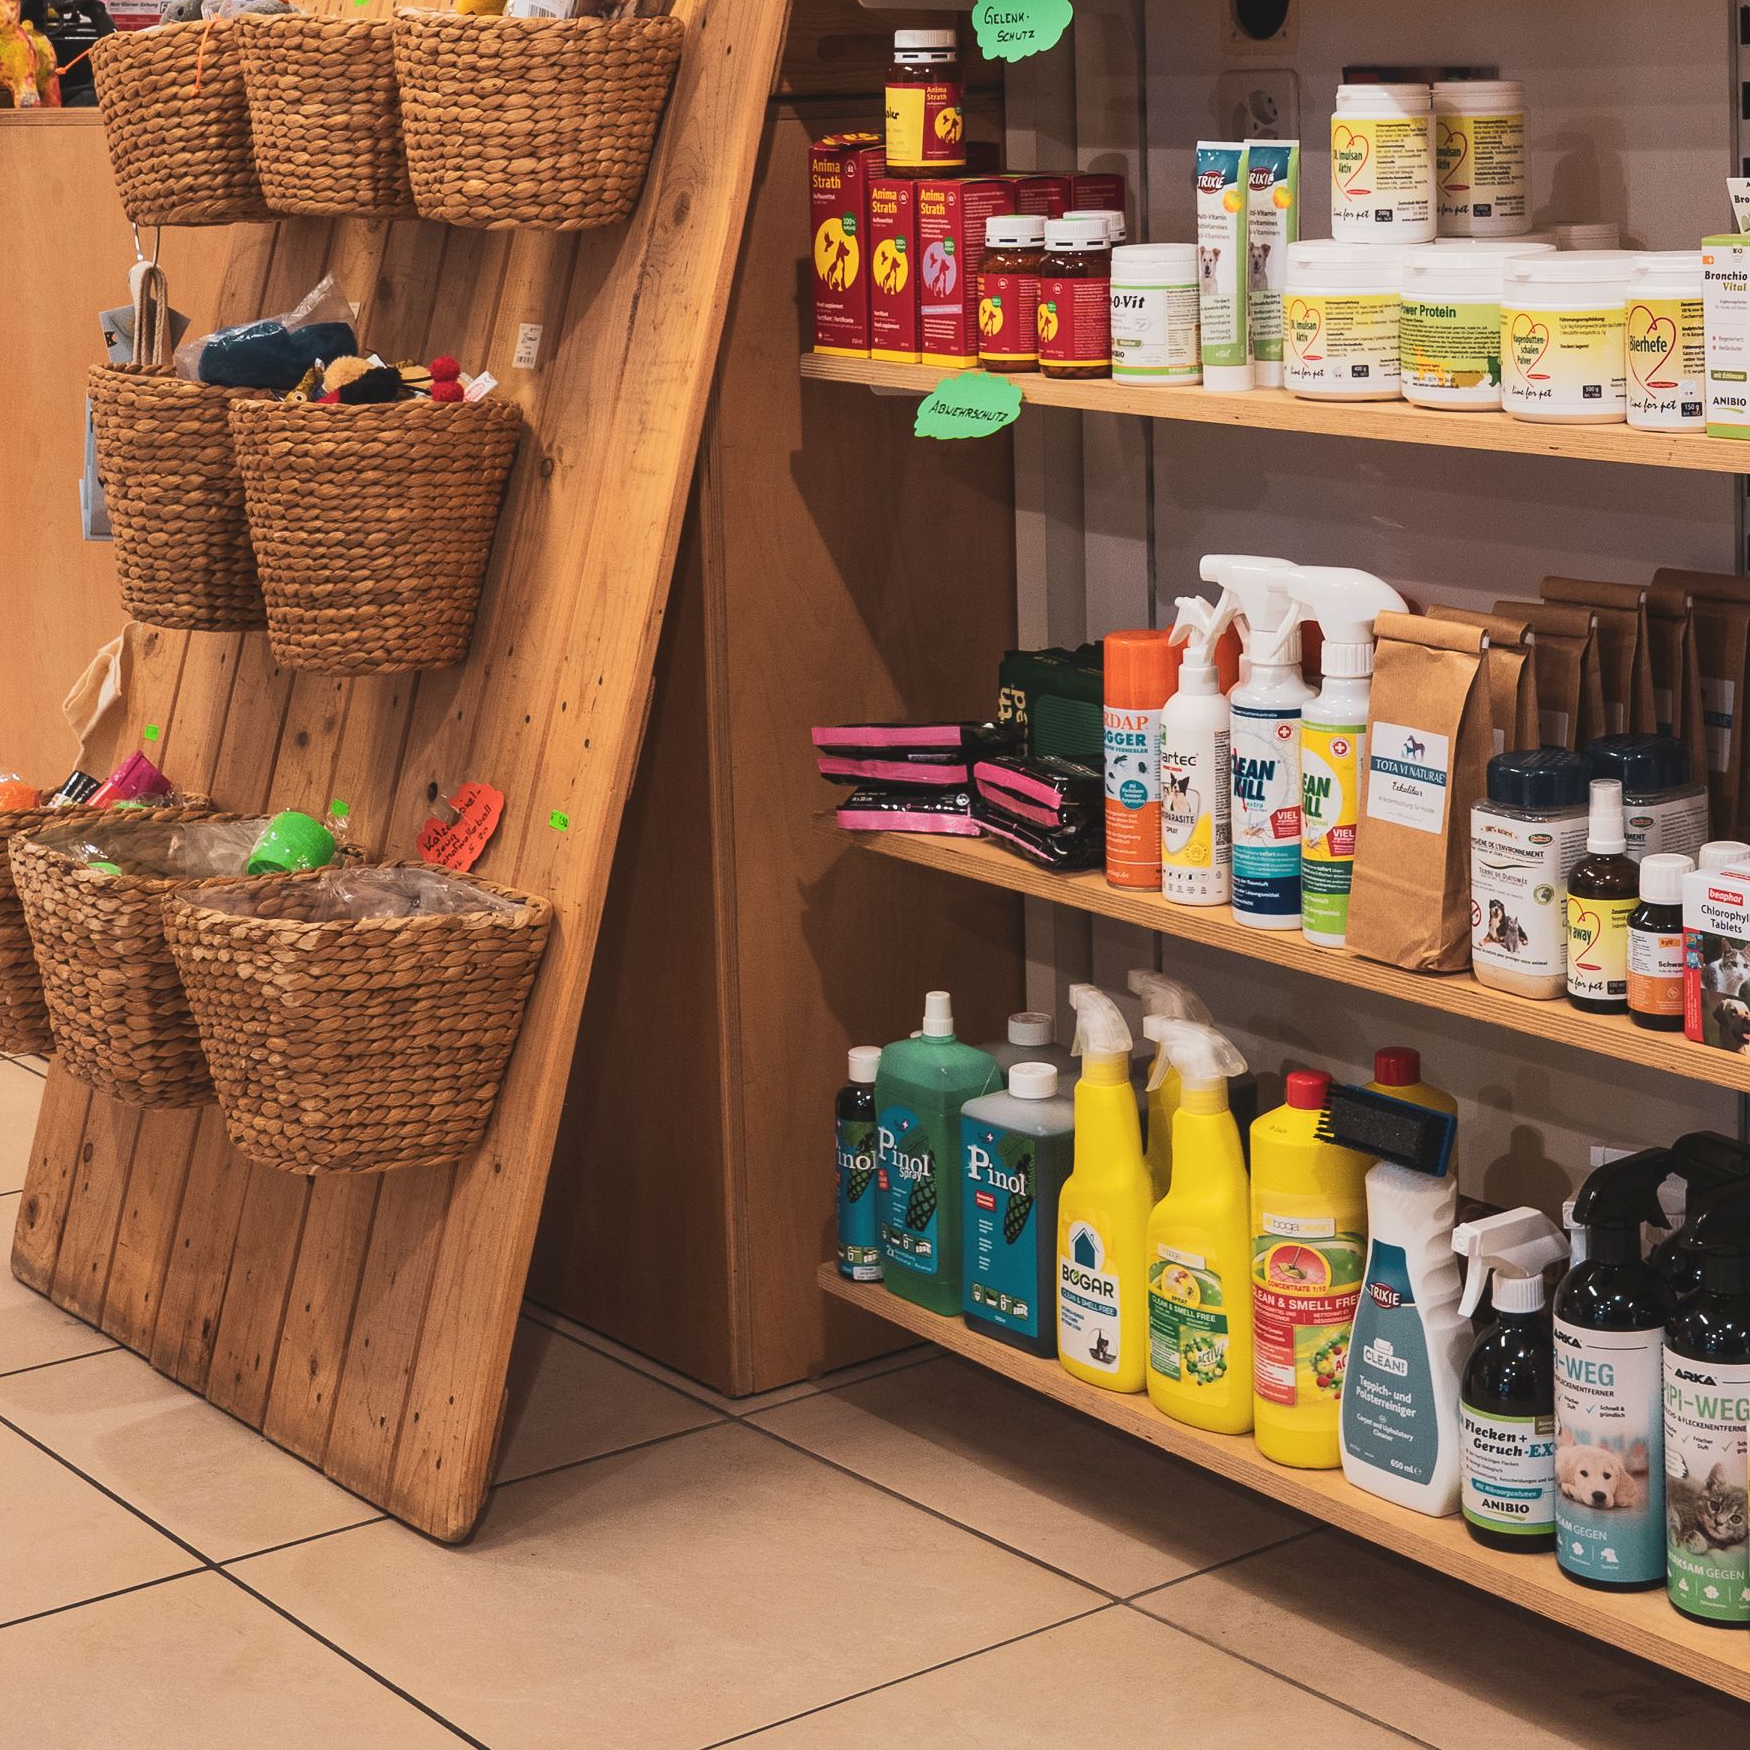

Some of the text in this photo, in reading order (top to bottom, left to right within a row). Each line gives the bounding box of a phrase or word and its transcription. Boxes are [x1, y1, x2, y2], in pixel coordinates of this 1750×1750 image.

[996, 28, 1036, 42] SCHUTZ
[812, 158, 841, 174] Anima
[812, 173, 841, 190] Strath
[872, 188, 898, 202] Anima
[920, 188, 945, 203] Anima
[872, 201, 898, 216] Strath
[920, 202, 946, 216] Strath
[1704, 270, 1748, 283] Bronchio
[1723, 281, 1747, 292] Vital
[1419, 305, 1457, 318] Protein
[1629, 334, 1668, 353] Bierhefe
[930, 399, 1008, 424] ABWEHRSCHUTZ
[1375, 758, 1447, 786] TOTA VI NATURAE
[1708, 889, 1743, 906] beaphar
[1710, 918, 1743, 934] Tablets
[878, 1125, 932, 1178] Pinol
[967, 1144, 1027, 1196] Pinol
[1061, 1263, 1115, 1299] BOGAR
[1267, 1279, 1311, 1293] CONCENTRATE
[1277, 1295, 1285, 1308] &
[1288, 1297, 1331, 1312] SMELL
[1369, 1284, 1401, 1306] TRIXIE
[1364, 1349, 1406, 1374] CLEAN!
[1675, 1367, 1717, 1387] ARKA
[1359, 1375, 1412, 1405] Teppich- und
[1355, 1386, 1417, 1419] Polsterreiniger
[1464, 1418, 1516, 1441] Flecken
[1473, 1436, 1554, 1458] Geruch-EX
[1390, 1458, 1416, 1474] 650 ml
[1482, 1497, 1530, 1515] ANIBIO
[1573, 1526, 1607, 1541] GEGEN
[1706, 1564, 1745, 1580] GEGEN
